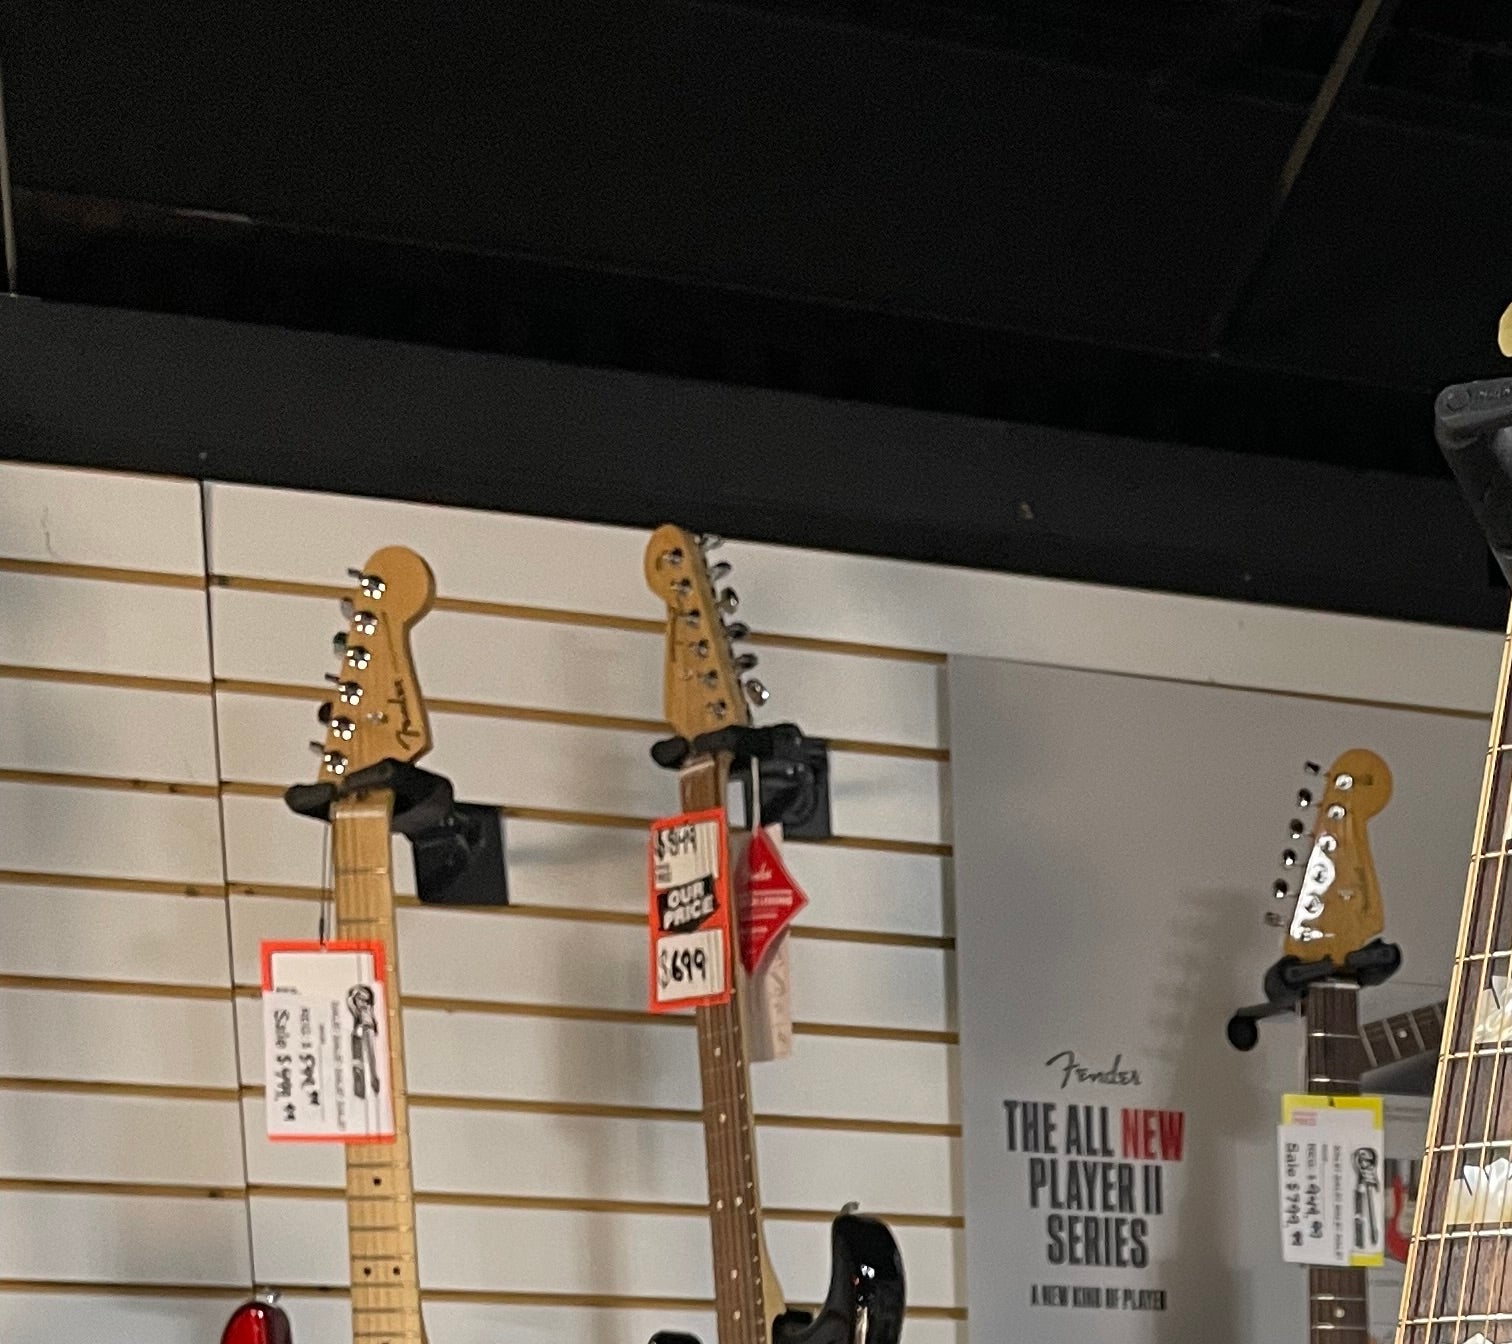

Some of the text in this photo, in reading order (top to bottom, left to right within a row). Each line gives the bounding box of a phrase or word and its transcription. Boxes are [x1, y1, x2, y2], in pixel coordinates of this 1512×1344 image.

[663, 894, 714, 930] PRICE
[667, 881, 704, 908] OUR
[1045, 1050, 1142, 1089] Fender
[1003, 1100, 1185, 1162] THE ALL NEW
[1285, 1143, 1299, 1177] Sale
[1029, 1157, 1163, 1215] PLAYER II
[1047, 1213, 1148, 1269] SERIES
